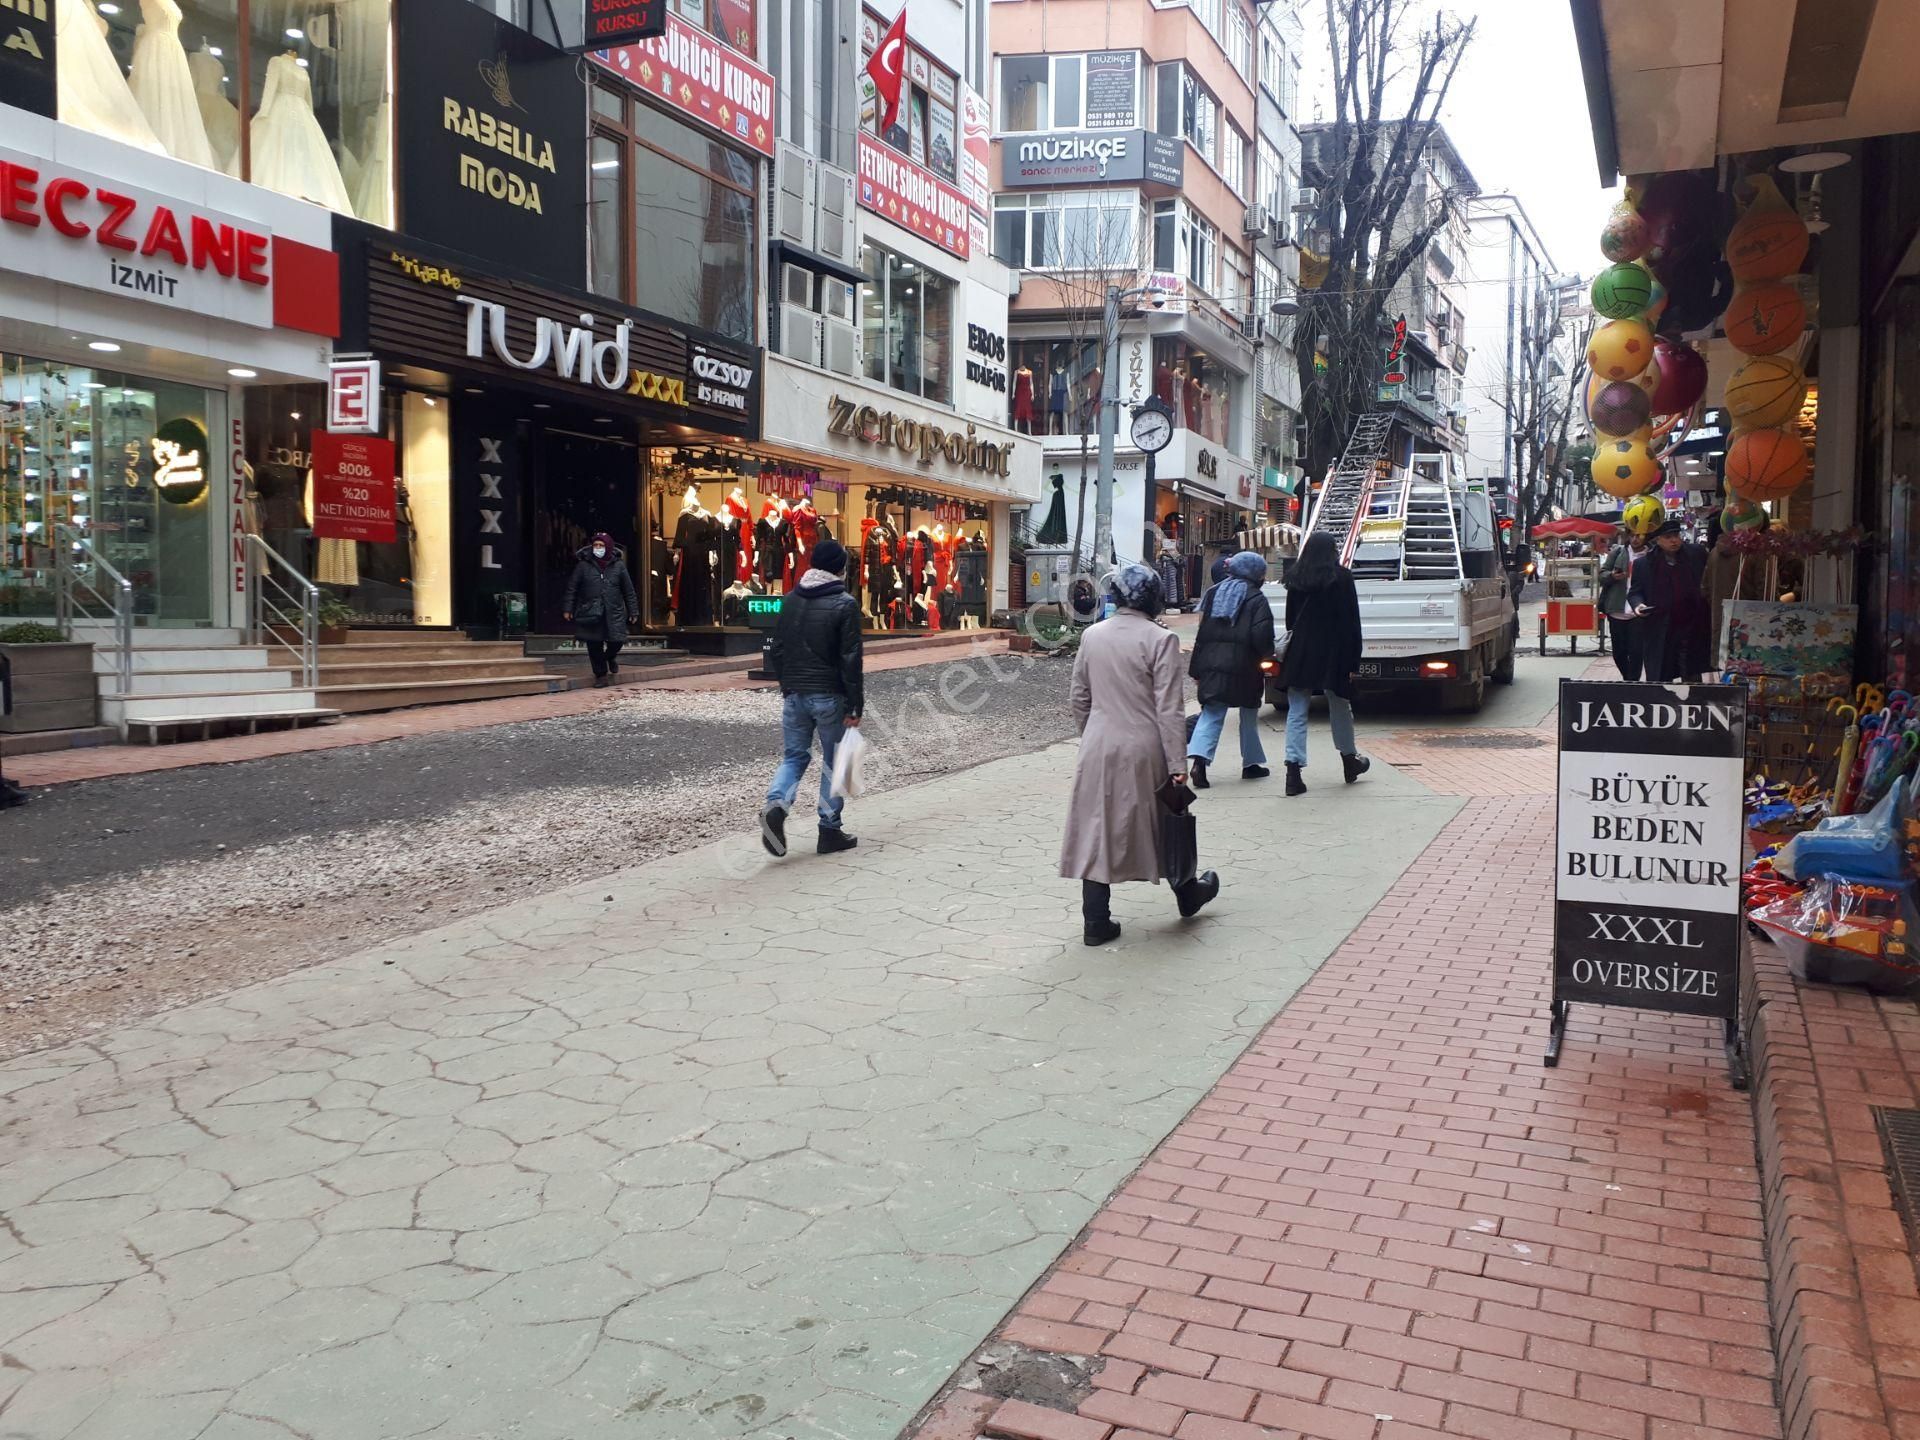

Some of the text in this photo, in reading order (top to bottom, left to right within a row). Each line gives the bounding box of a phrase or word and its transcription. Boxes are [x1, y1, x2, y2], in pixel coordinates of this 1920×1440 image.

[596, 11, 648, 34] KURSU
[658, 22, 771, 121] SÜRÜCÜ KURSU
[443, 97, 556, 174] RABELLA
[460, 153, 543, 216] MODA
[860, 142, 899, 194] FETHİYE
[899, 164, 937, 216] SÜRÜCÜ
[938, 188, 968, 232] KURSU
[0, 159, 270, 287] ECZANE
[110, 257, 179, 299] İZMİT
[967, 322, 1006, 363] EROS
[693, 346, 753, 389] ÖZSOY
[340, 375, 363, 418] E
[626, 369, 690, 408] XXXL
[231, 418, 246, 593] ECZANE
[320, 502, 391, 519] NET İNDİRİM
[342, 486, 369, 501] %20
[479, 437, 504, 569] XXXL
[748, 598, 782, 613] FETHİ
[1571, 701, 1733, 733] JARDEN
[1589, 771, 1710, 808] BÜYÜK
[1591, 815, 1705, 847] BEDEN
[1566, 852, 1730, 887] BULUNUR
[1586, 911, 1705, 948] XXXL
[1571, 958, 1719, 997] OVERSİZE
